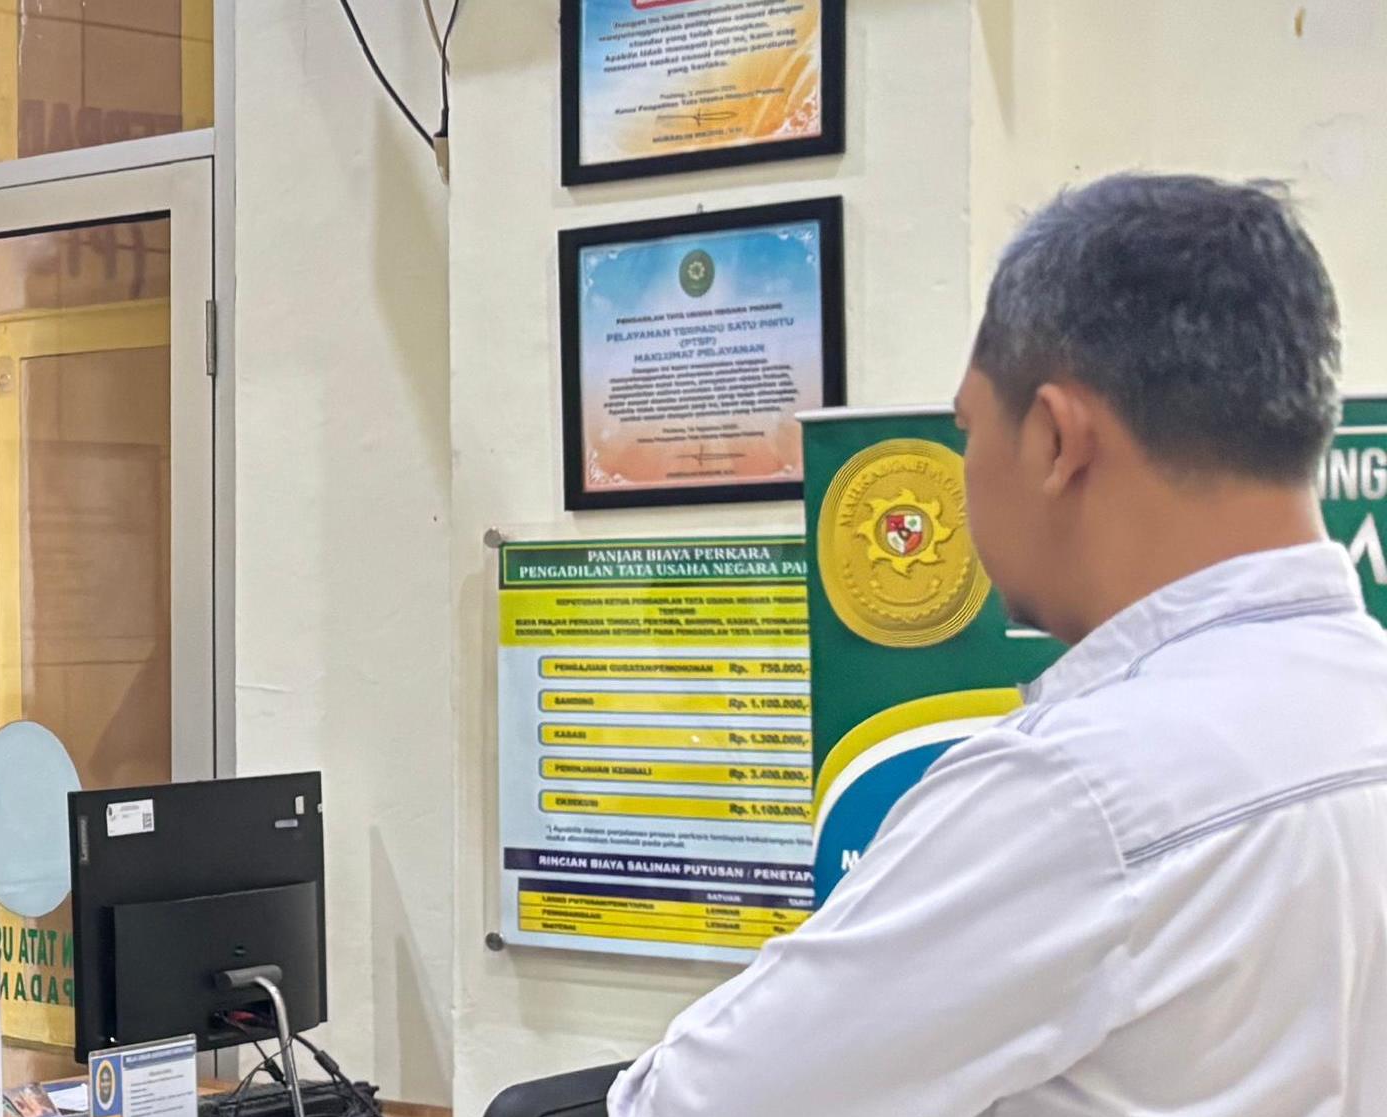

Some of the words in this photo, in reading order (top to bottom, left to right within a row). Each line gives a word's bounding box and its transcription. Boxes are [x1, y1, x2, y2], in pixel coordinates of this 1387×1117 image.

[587, 549, 643, 564] PANJAR
[646, 548, 692, 562] BIAYA
[694, 547, 770, 561] PERKARA
[519, 565, 614, 579] PENGADILAN
[617, 564, 653, 577] TATA
[656, 563, 709, 576] USAHA
[713, 562, 777, 575] NEGARA
[538, 855, 588, 868] RINCIAN
[590, 858, 625, 871] BIAYA
[627, 860, 680, 875] SALINAN
[683, 865, 743, 878] PUTUSAN
